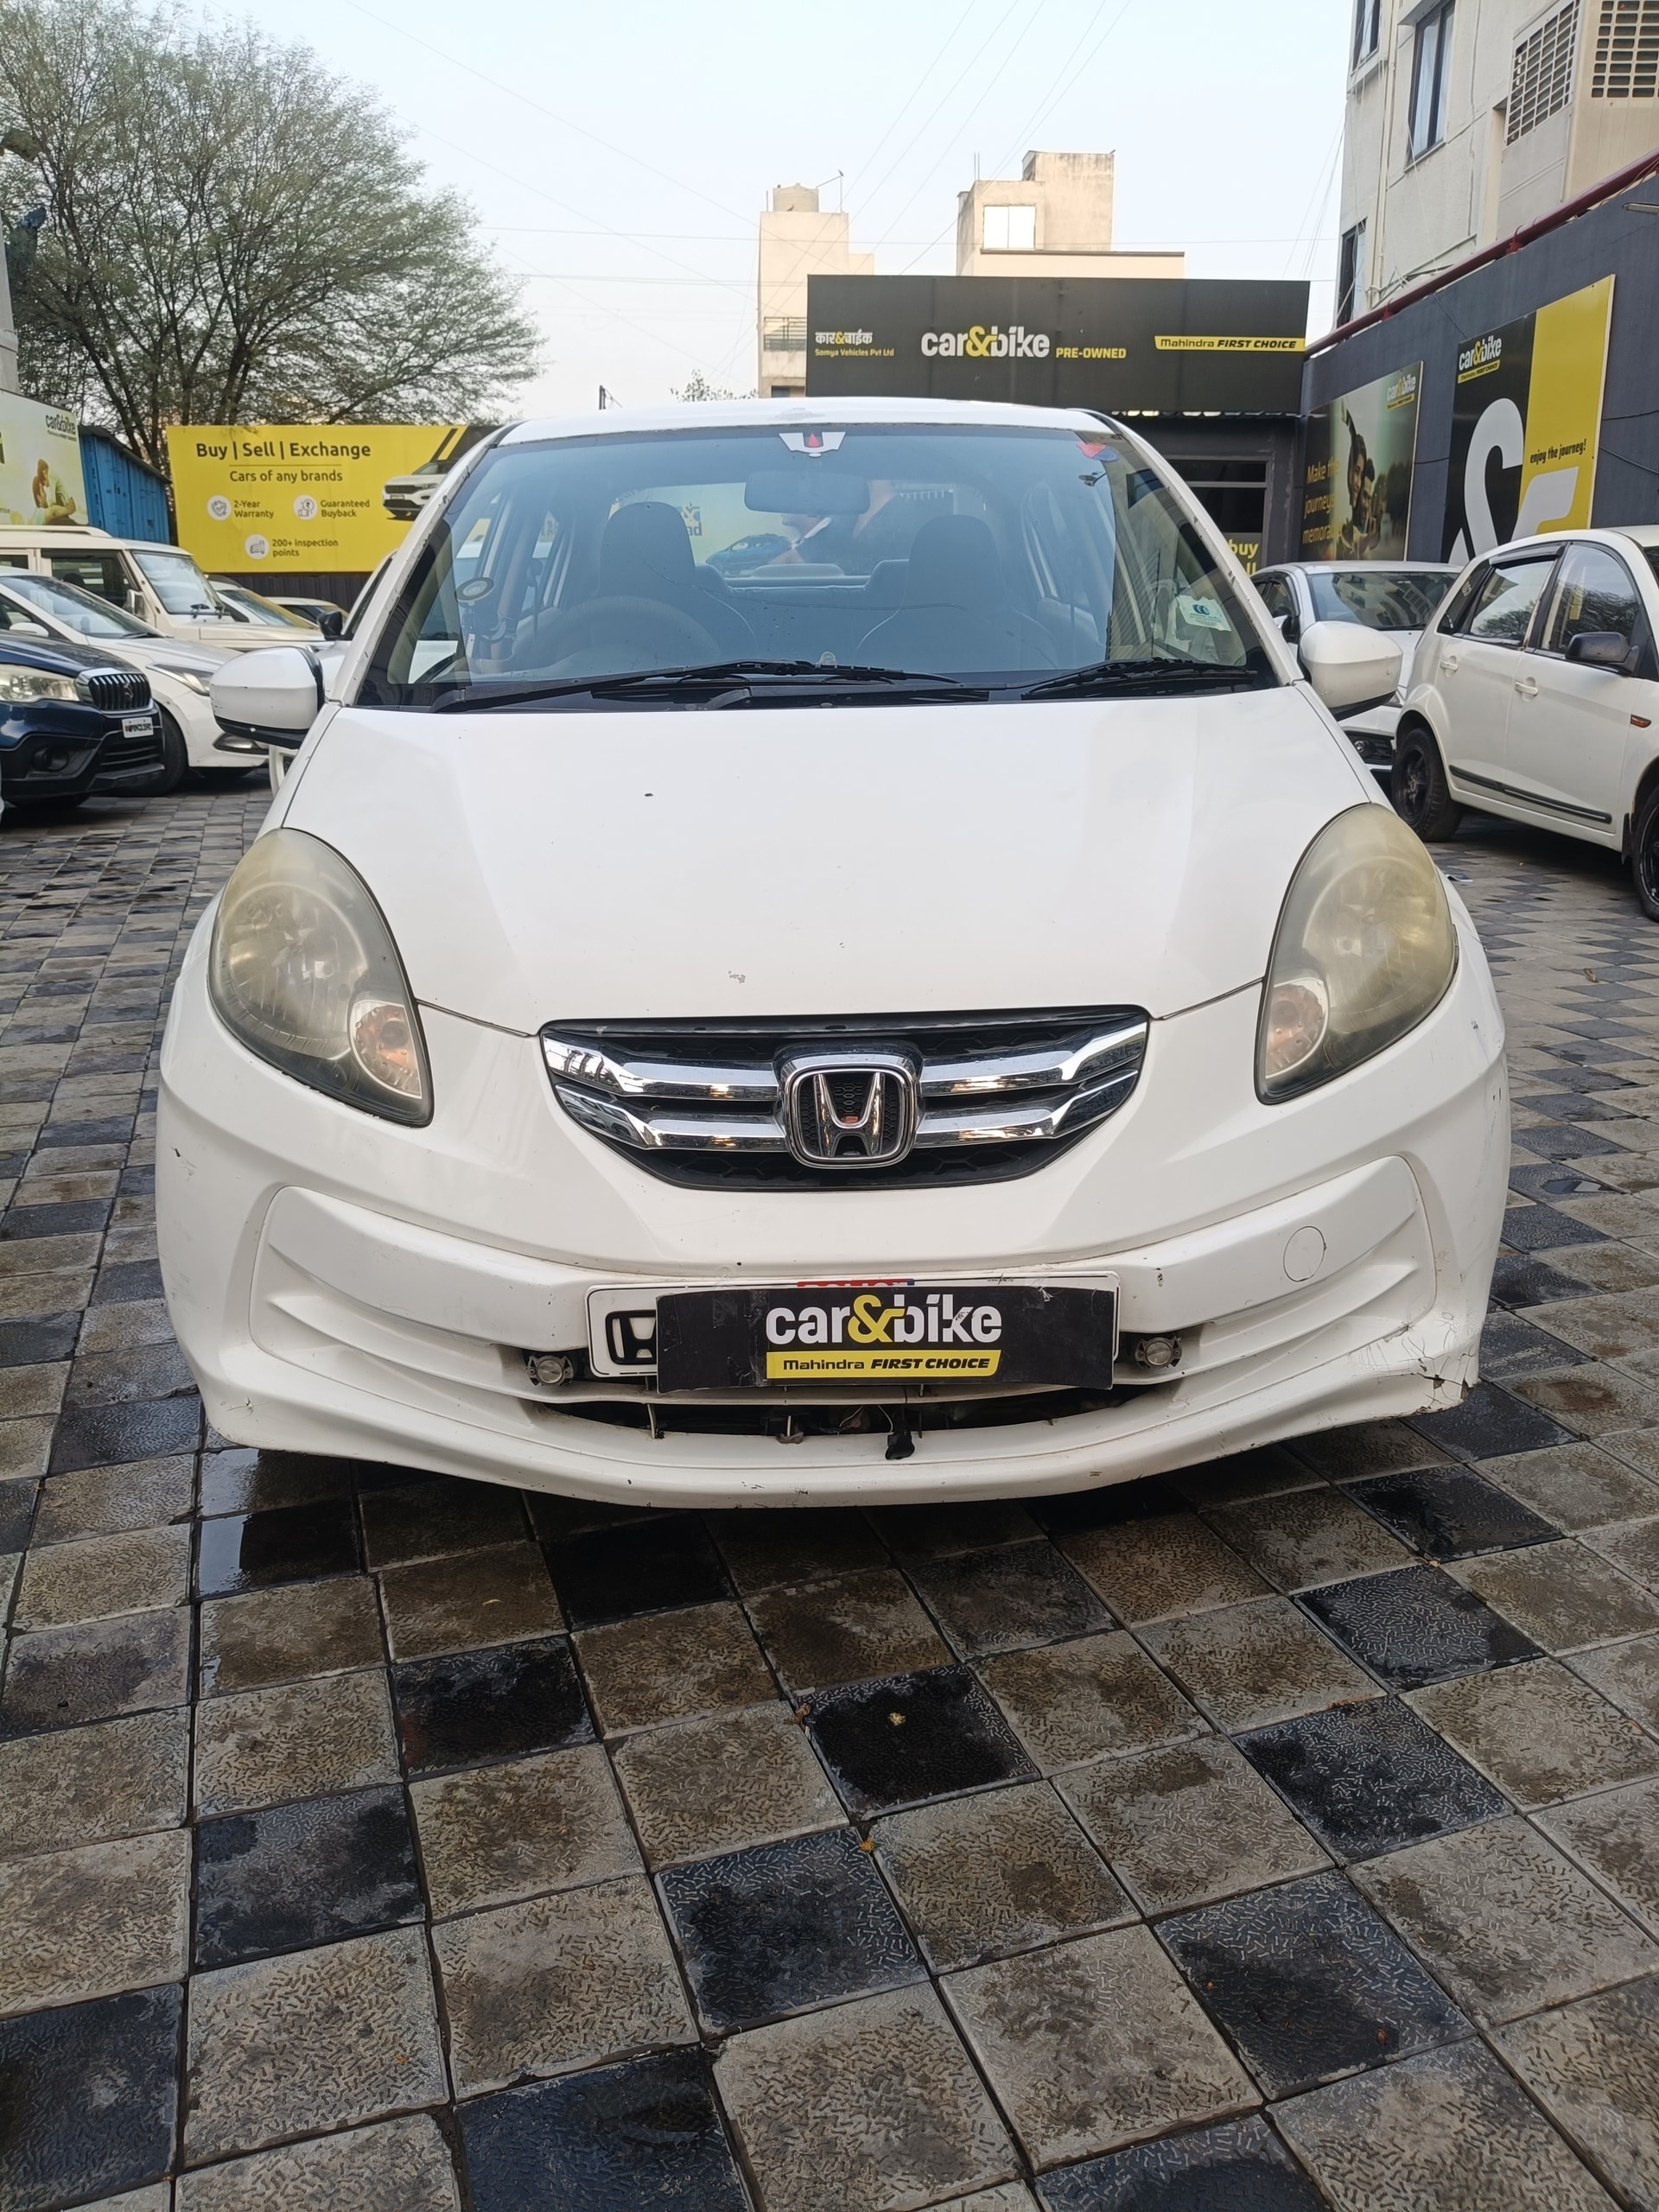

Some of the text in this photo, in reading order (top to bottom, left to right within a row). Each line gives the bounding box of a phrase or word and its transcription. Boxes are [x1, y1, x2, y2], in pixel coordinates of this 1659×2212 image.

[921, 326, 1050, 358] car&bike
[1160, 339, 1296, 349] Mahindra FIRST CHOICE
[815, 348, 894, 358] Somya Vehicles Pvt Ltd
[1056, 347, 1127, 359] PRE-OWNED
[1459, 334, 1502, 372] car&bike
[196, 442, 227, 460] Buy
[243, 442, 276, 457] Sell
[289, 442, 372, 460] Exchange
[1529, 437, 1587, 466] enjoy the journey!
[230, 469, 343, 484] Cars of any brands
[1306, 461, 1327, 485] Make
[233, 499, 261, 509] 2-Year
[320, 499, 371, 508] Guaranteed
[234, 510, 275, 519] Warranty
[321, 510, 358, 519] Buyback
[272, 538, 340, 549] 200+ inspection
[1228, 538, 1259, 559] buy
[272, 549, 300, 558] points
[766, 1294, 1003, 1345] car&bike
[783, 1357, 991, 1370] Mahindra FIRST CHOICE
